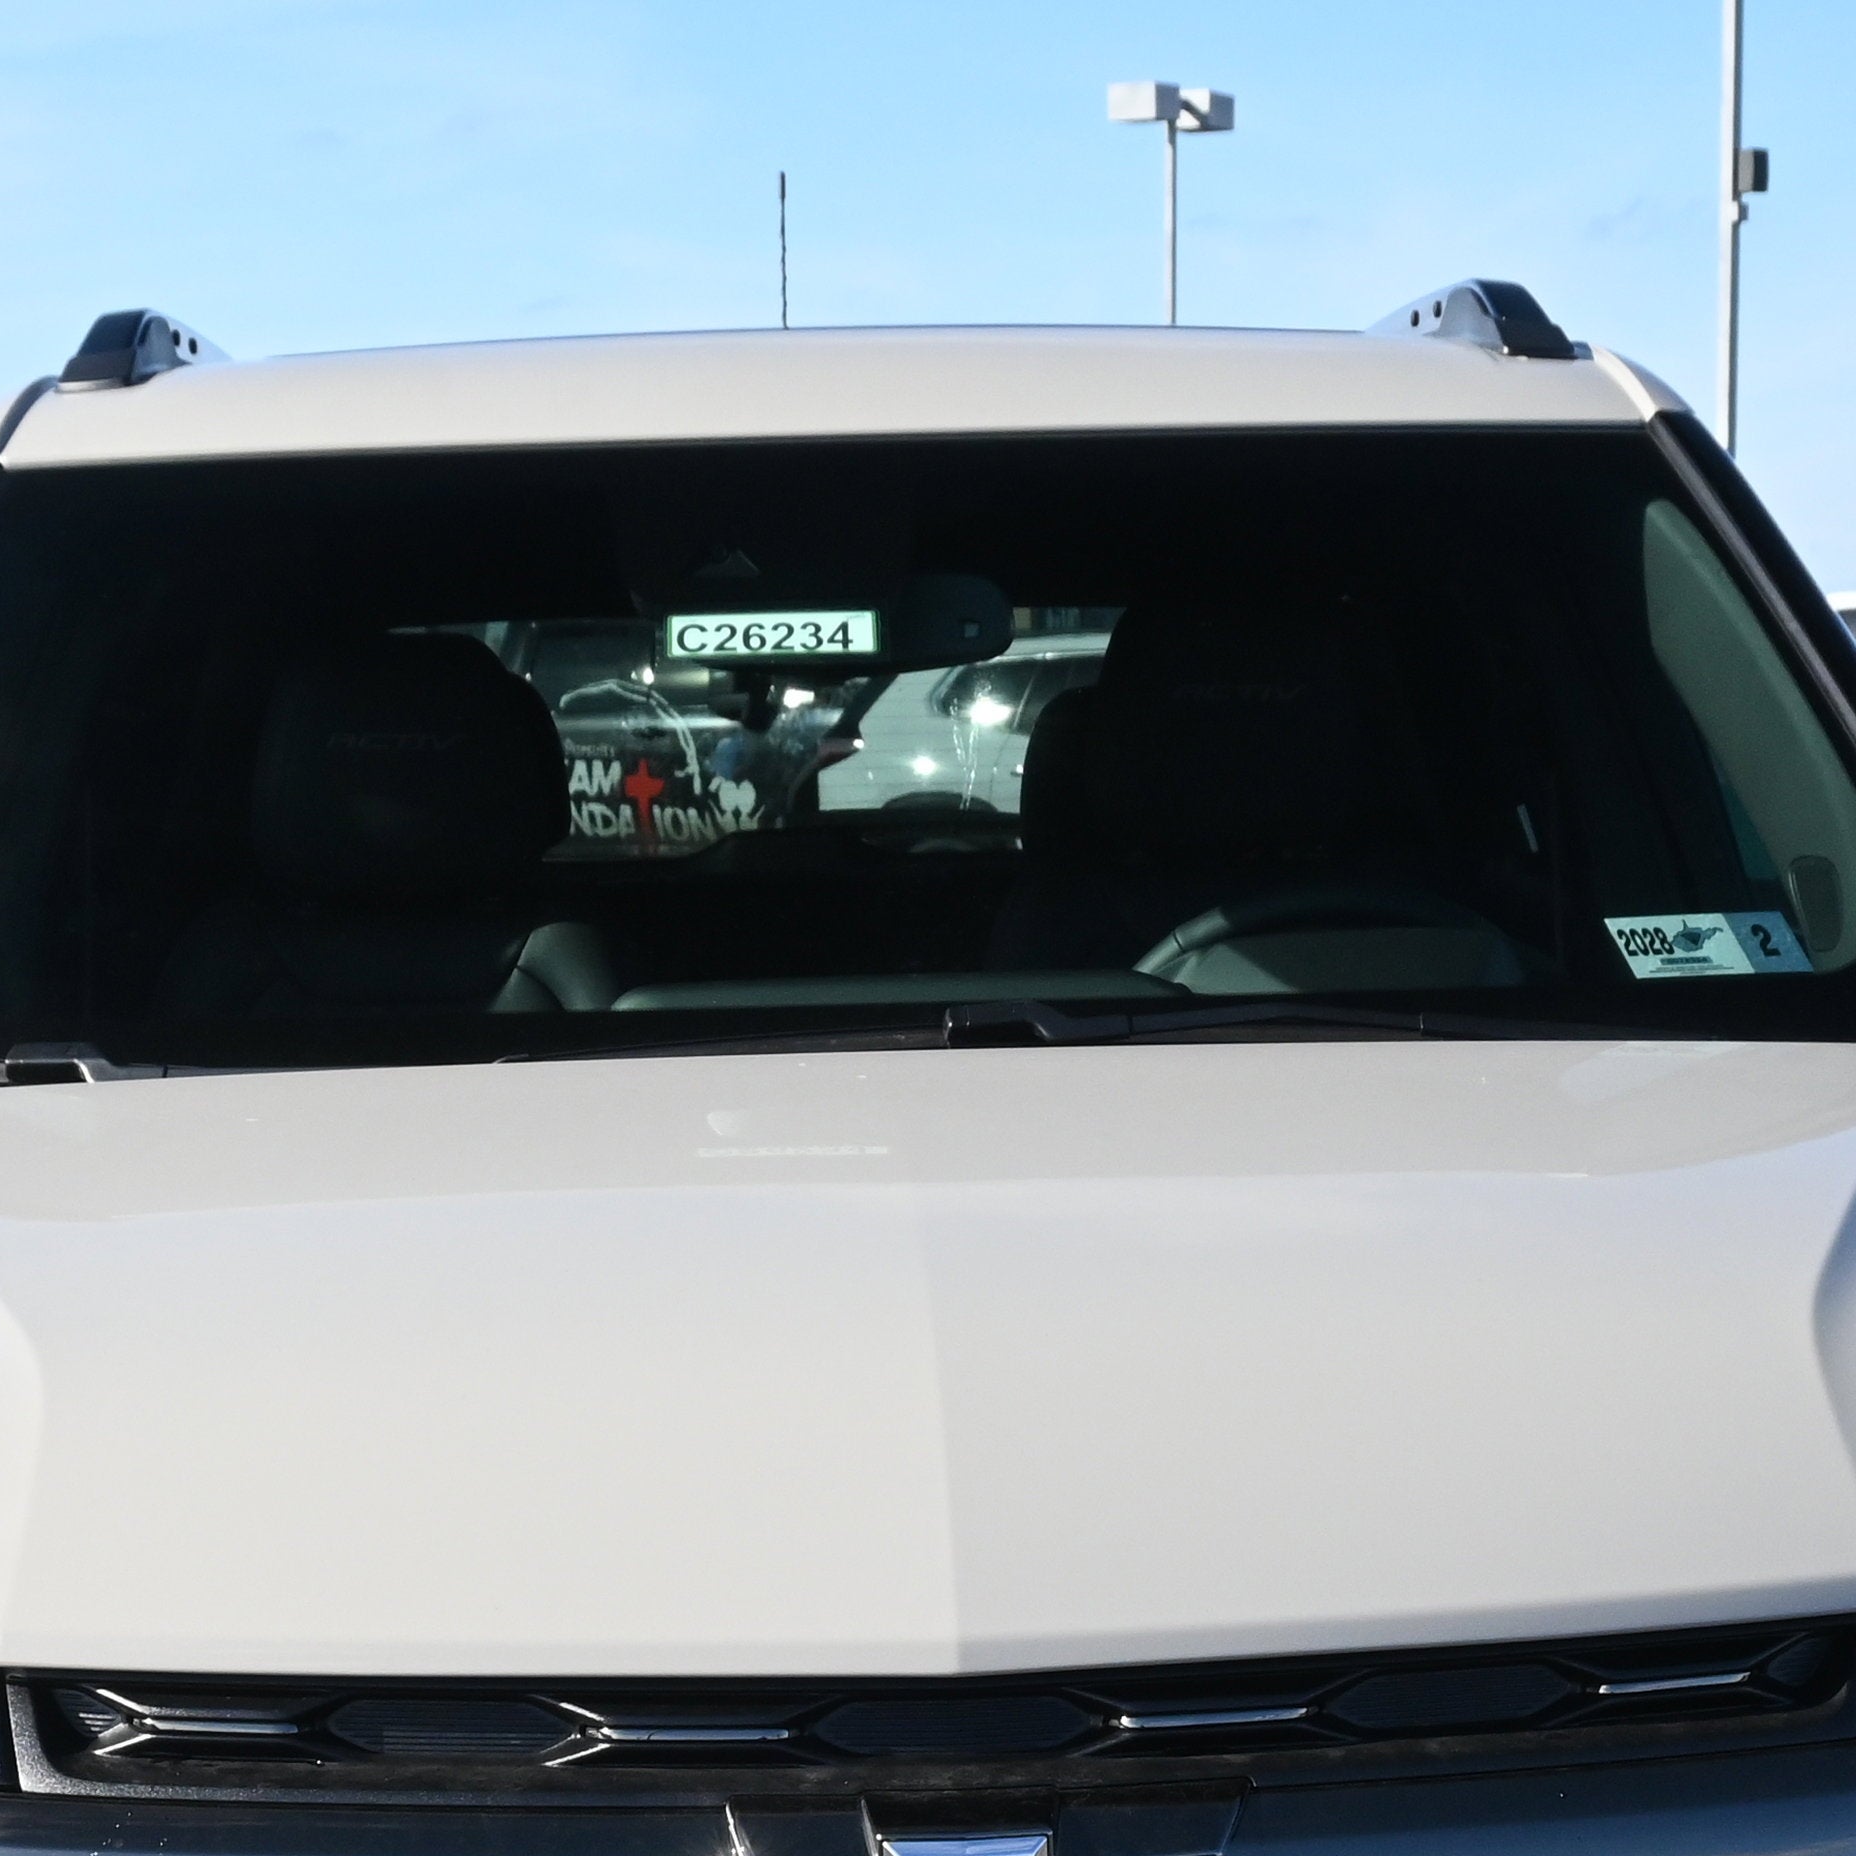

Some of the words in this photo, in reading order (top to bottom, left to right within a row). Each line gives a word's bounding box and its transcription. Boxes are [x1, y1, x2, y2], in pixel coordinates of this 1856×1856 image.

[676, 622, 853, 652] C26234
[566, 758, 622, 796] AM
[1617, 927, 1675, 957] 2028
[1750, 923, 1782, 957] 2
